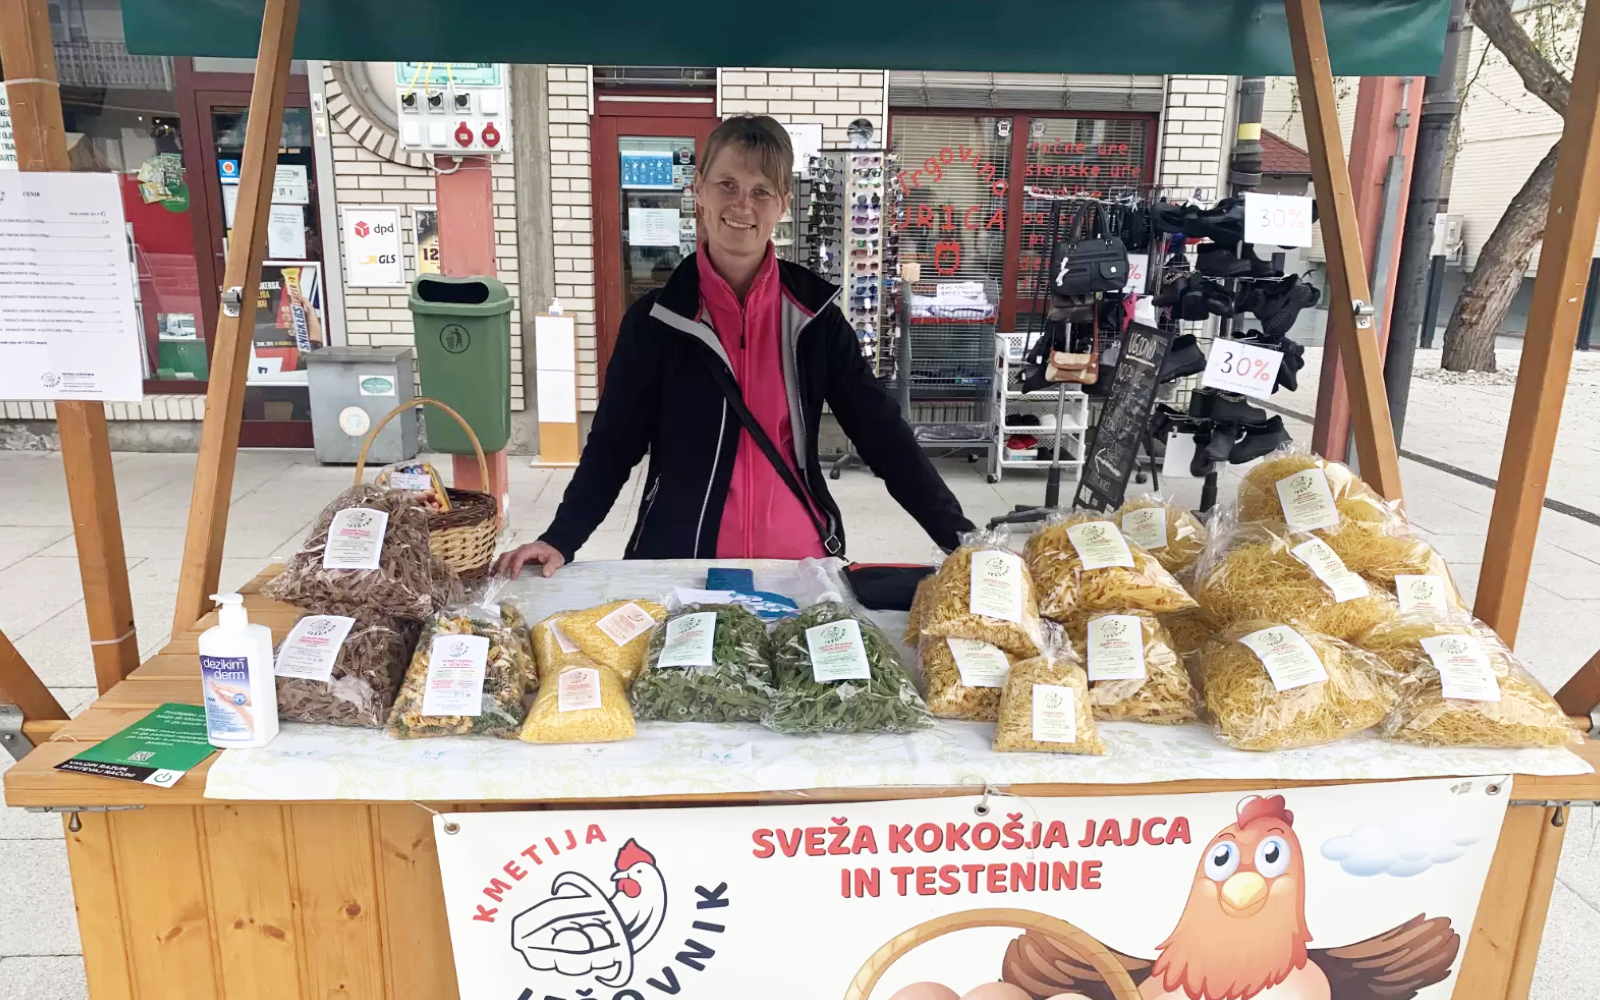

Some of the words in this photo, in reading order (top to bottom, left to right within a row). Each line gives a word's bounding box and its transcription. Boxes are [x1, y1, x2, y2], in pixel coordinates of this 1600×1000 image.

[1031, 138, 1086, 155] ročne
[1098, 142, 1128, 156] ure
[897, 145, 1008, 197] Trgovina
[1110, 165, 1141, 178] ure
[1260, 208, 1305, 229] 30%
[373, 223, 395, 236] dpd
[378, 254, 396, 265] GLS
[293, 306, 311, 352] SNICKERS
[1220, 351, 1270, 381] 30%
[203, 658, 245, 670] dezikim
[214, 671, 246, 680] derm
[752, 816, 878, 859] SVEŽA
[888, 812, 1069, 853] KOKOŠJA
[1077, 816, 1192, 848] JAJCA
[472, 823, 607, 923] KMETIJA
[840, 868, 881, 899] IN
[890, 860, 1103, 896] TESTENINE
